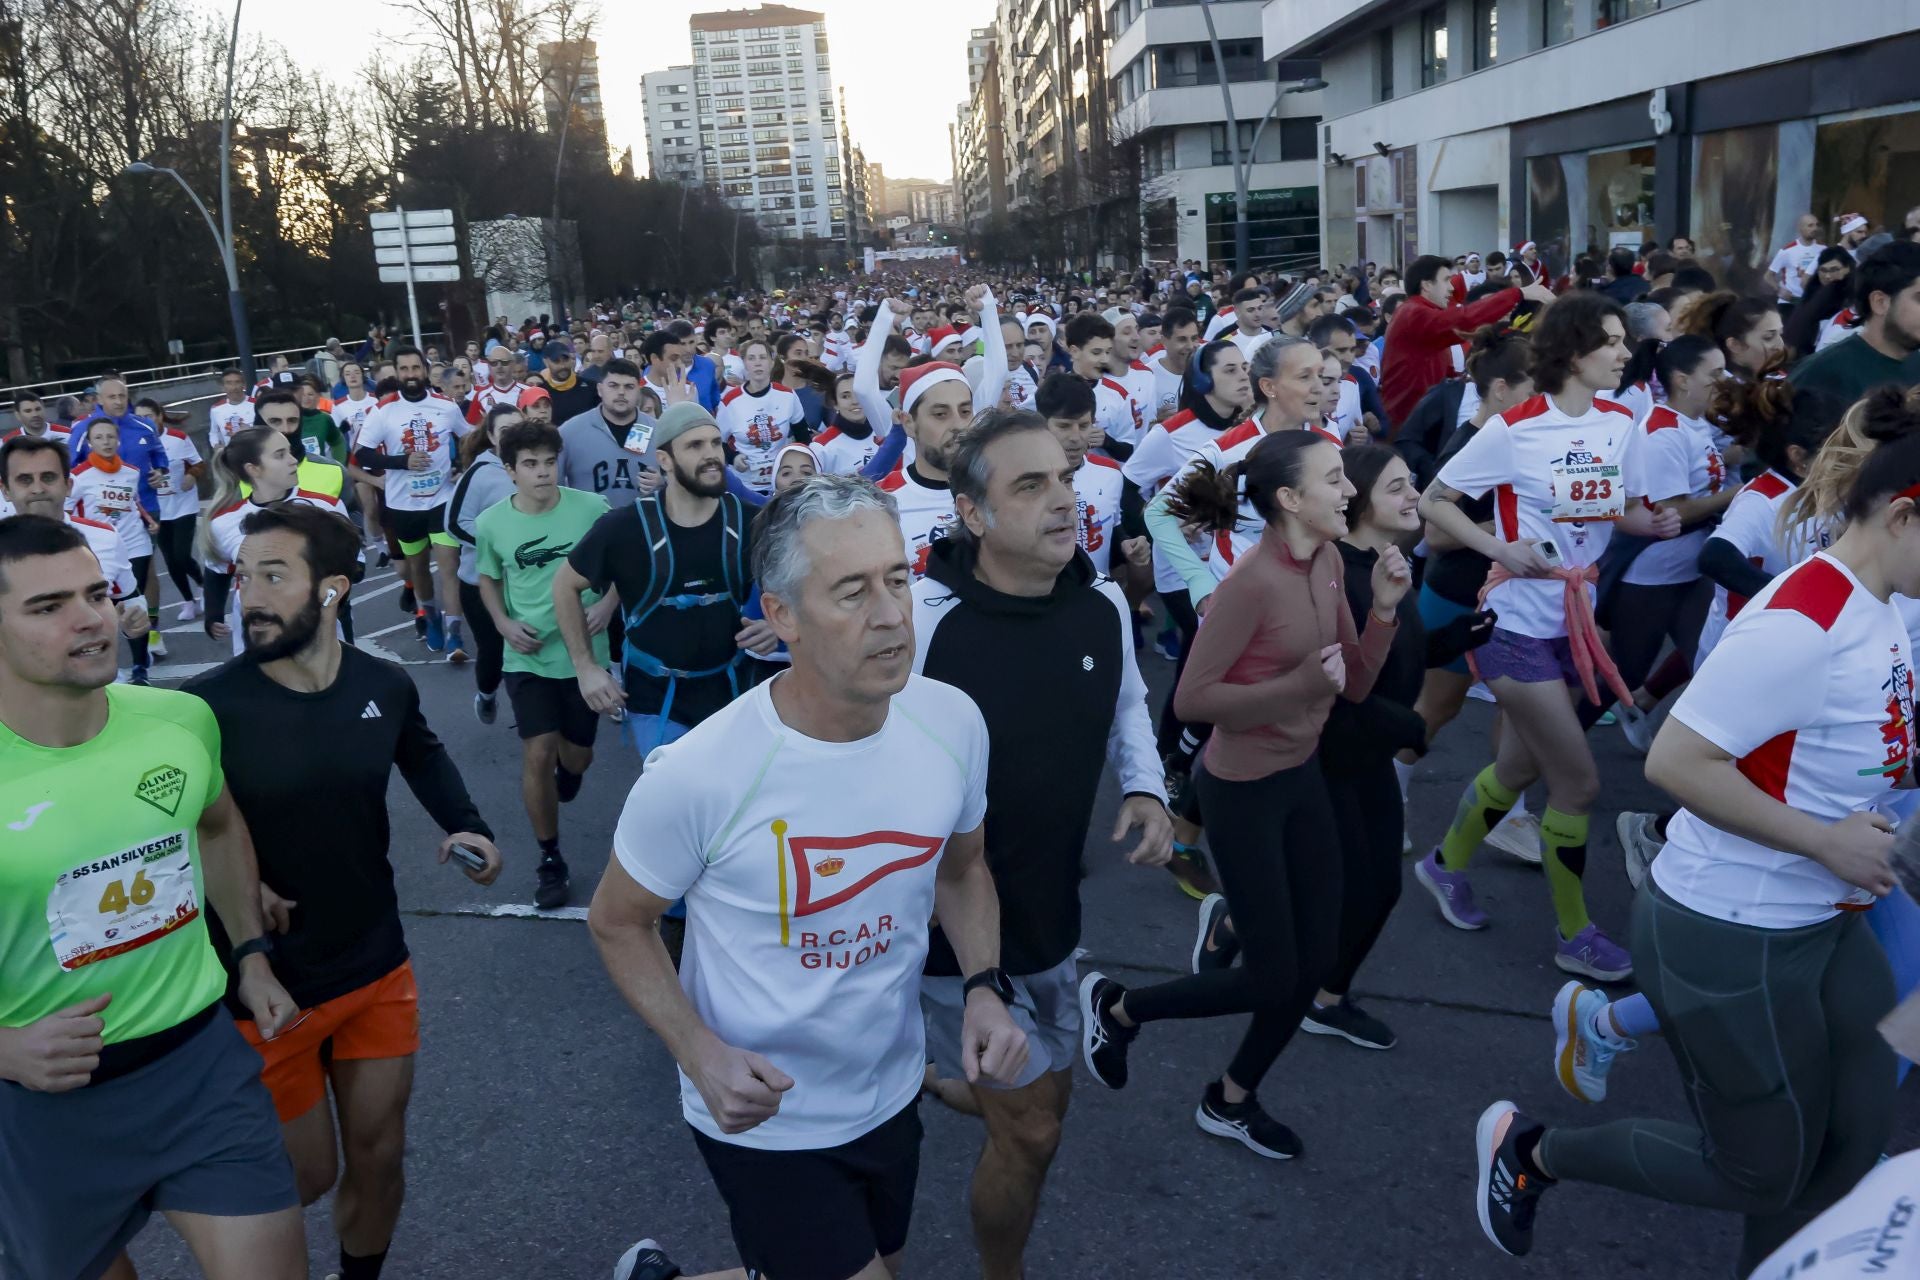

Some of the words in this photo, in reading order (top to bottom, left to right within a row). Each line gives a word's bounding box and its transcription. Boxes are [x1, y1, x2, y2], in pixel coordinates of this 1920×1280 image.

[1576, 466, 1591, 474] SAN
[1591, 464, 1619, 473] SILVESTRE
[102, 490, 130, 501] 1065
[1570, 479, 1612, 501] 823
[138, 768, 181, 790] OLIVER
[145, 778, 181, 796] TRAINING
[72, 867, 91, 879] 55
[91, 857, 120, 873] SAN
[121, 833, 182, 864] SILVESTRE
[99, 869, 156, 914] 46
[801, 914, 899, 948] R.C.A.R.
[800, 939, 891, 969] GIJON
